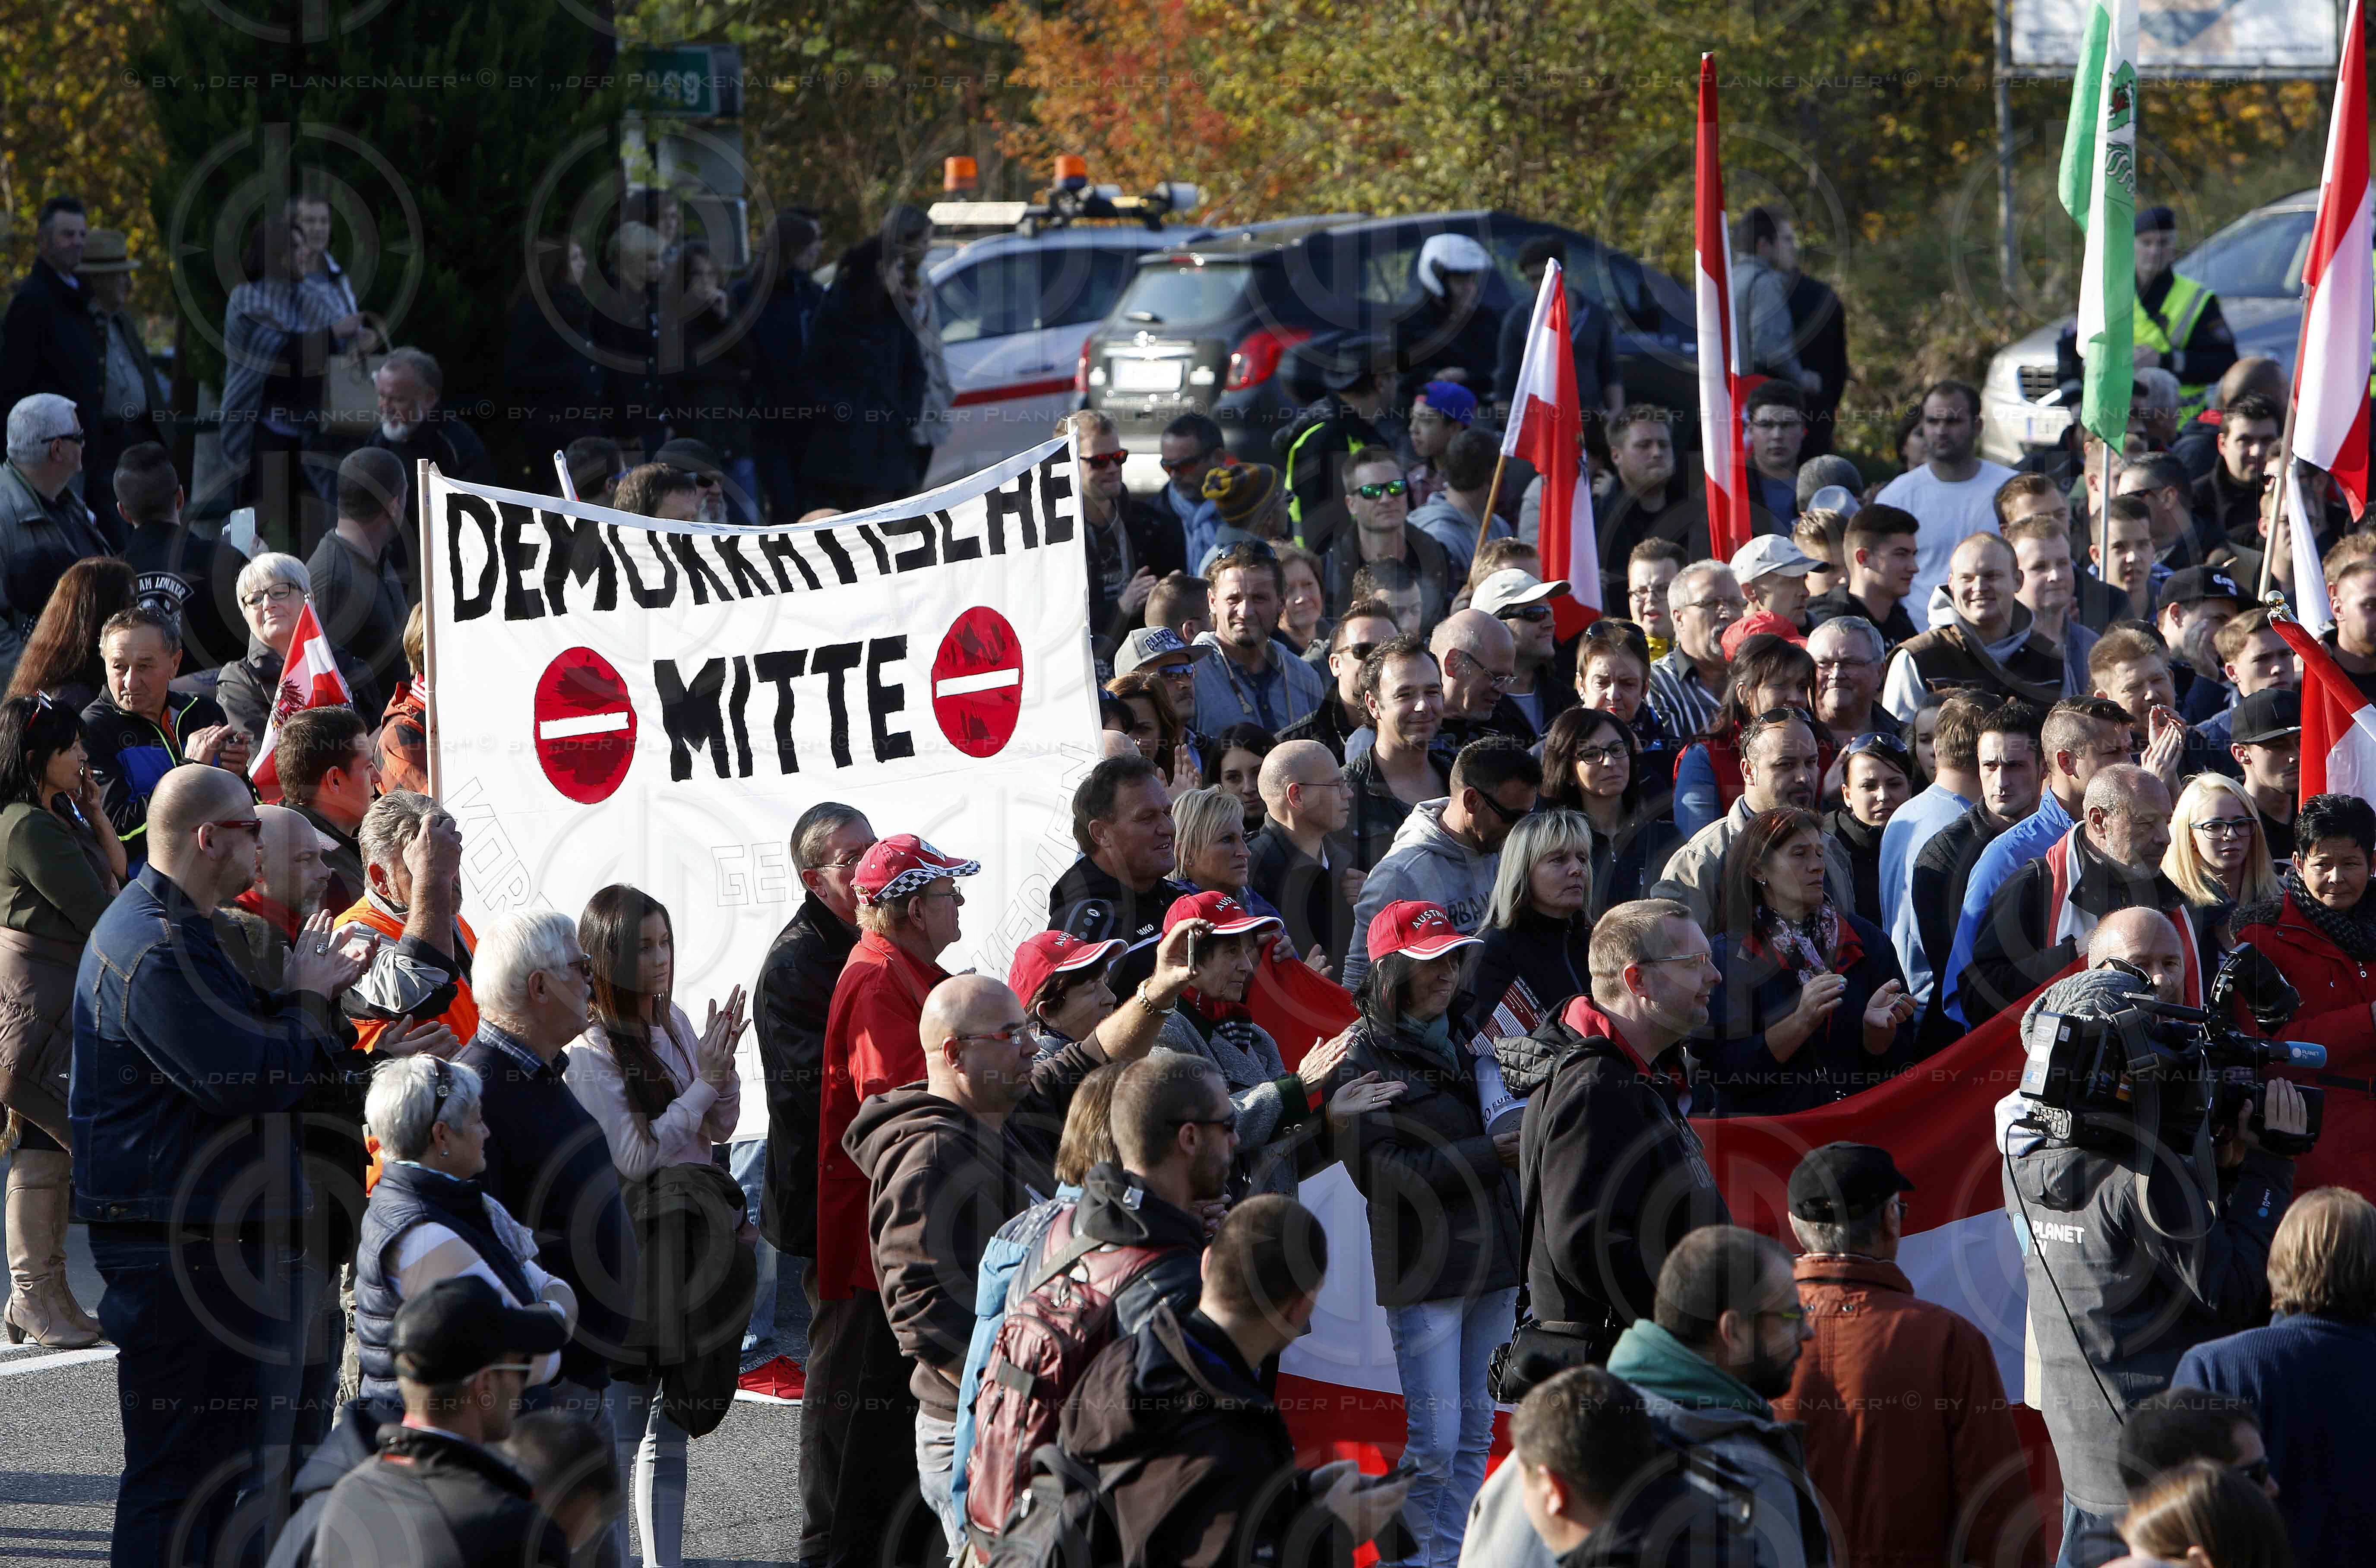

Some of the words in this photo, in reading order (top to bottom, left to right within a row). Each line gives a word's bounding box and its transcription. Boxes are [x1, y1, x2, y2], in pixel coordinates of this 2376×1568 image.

[654, 634, 914, 782] MITTE
[1412, 909, 1450, 929] AUSTRIA
[2032, 1220, 2085, 1244] PLANET
